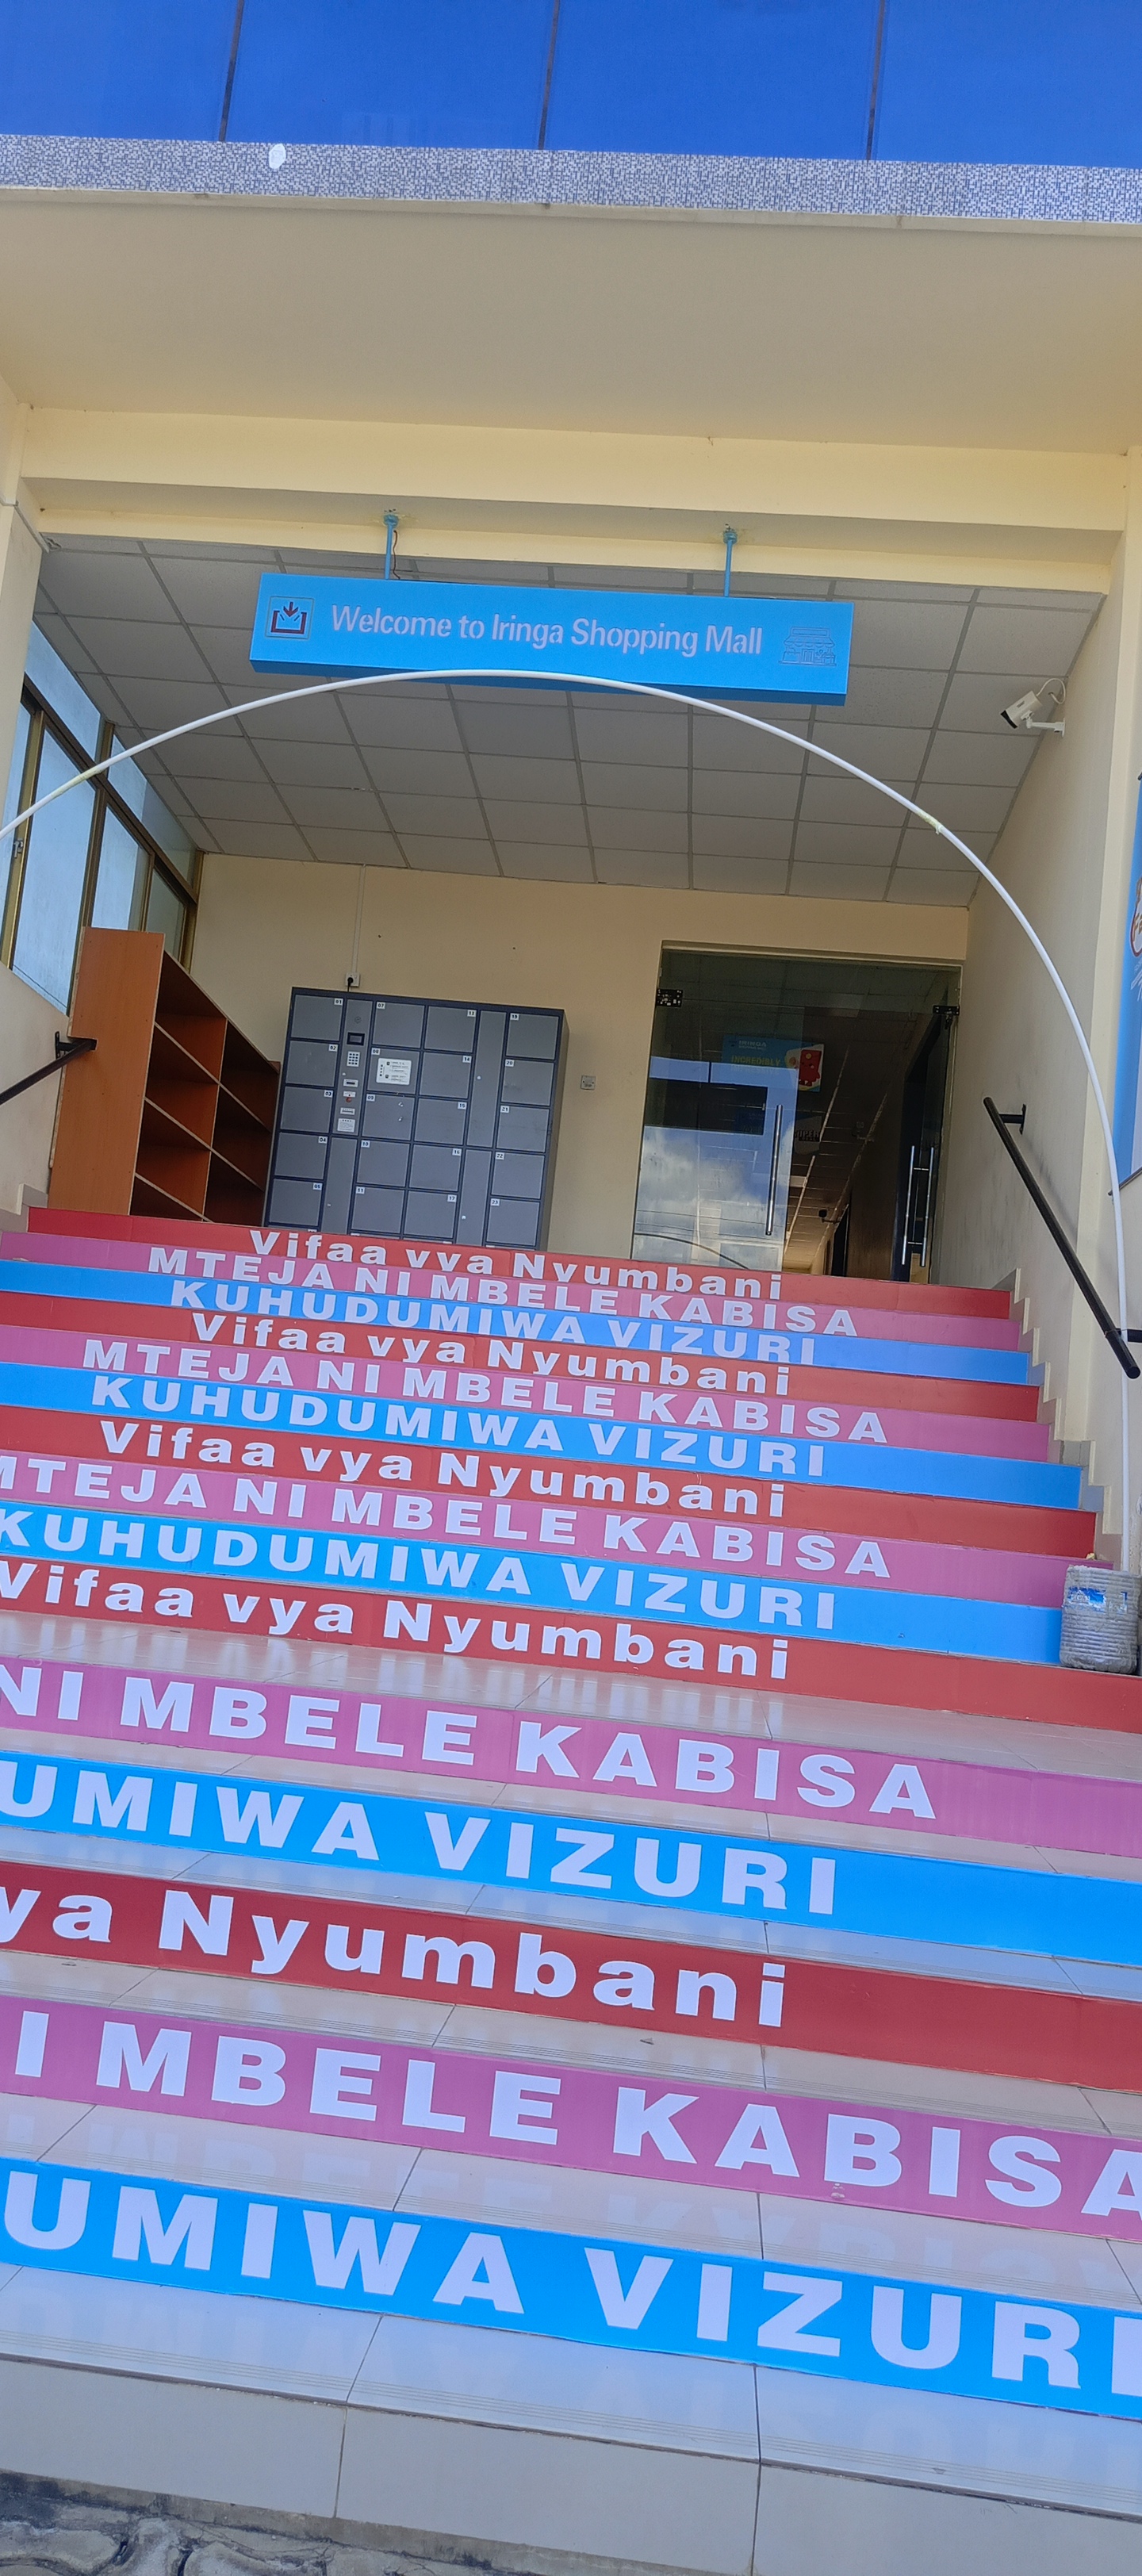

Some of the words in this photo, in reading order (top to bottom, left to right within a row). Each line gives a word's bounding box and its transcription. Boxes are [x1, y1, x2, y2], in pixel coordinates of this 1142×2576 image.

[331, 604, 452, 638] Welcome
[458, 615, 486, 639] to
[491, 613, 565, 651] Iringa
[571, 617, 699, 659] Shopping
[705, 625, 764, 656] Mall
[731, 1055, 781, 1066] INCREDIBLY
[147, 1246, 335, 1290] MTEJA
[354, 1266, 411, 1297] NI
[429, 1273, 619, 1316] MBELE
[638, 1292, 858, 1337] KABISA
[249, 1229, 386, 1265] Vifaa
[512, 1252, 780, 1300] Nyumbani
[170, 1279, 586, 1344] KUHUDUMIWA
[607, 1319, 814, 1366] VIZURI
[192, 1312, 346, 1354] Vifaa
[366, 1335, 466, 1363] vya
[487, 1338, 789, 1396] Nyumbani
[82, 1338, 294, 1386] MTEJA
[316, 1359, 381, 1393] NI
[401, 1367, 616, 1417] MBELE
[637, 1390, 887, 1443] KABISA
[91, 1374, 563, 1451] KUHUDUMIWA
[588, 1423, 824, 1477] VIZURI
[99, 1420, 275, 1467] Vifaa
[300, 1446, 412, 1482] vya
[437, 1451, 784, 1517] Nyumbani
[0, 1508, 531, 1595] KUHUDUMIWA
[560, 1562, 834, 1630] VIZURI
[232, 1477, 307, 1519] NI
[330, 1487, 577, 1545] MBELE
[602, 1513, 891, 1578] KABISA
[0, 1559, 194, 1618] Vifaa
[222, 1593, 354, 1635] vya
[382, 1599, 788, 1680] Nyumbani
[119, 1675, 477, 1766] MBELE
[515, 1719, 937, 1819] KABISA
[424, 1811, 835, 1915] VIZURI
[158, 1889, 785, 2027] Nyumbani
[94, 2020, 561, 2145] MBELE
[611, 2085, 1142, 2221] KABISA
[584, 2248, 1142, 2397] VIZURI
